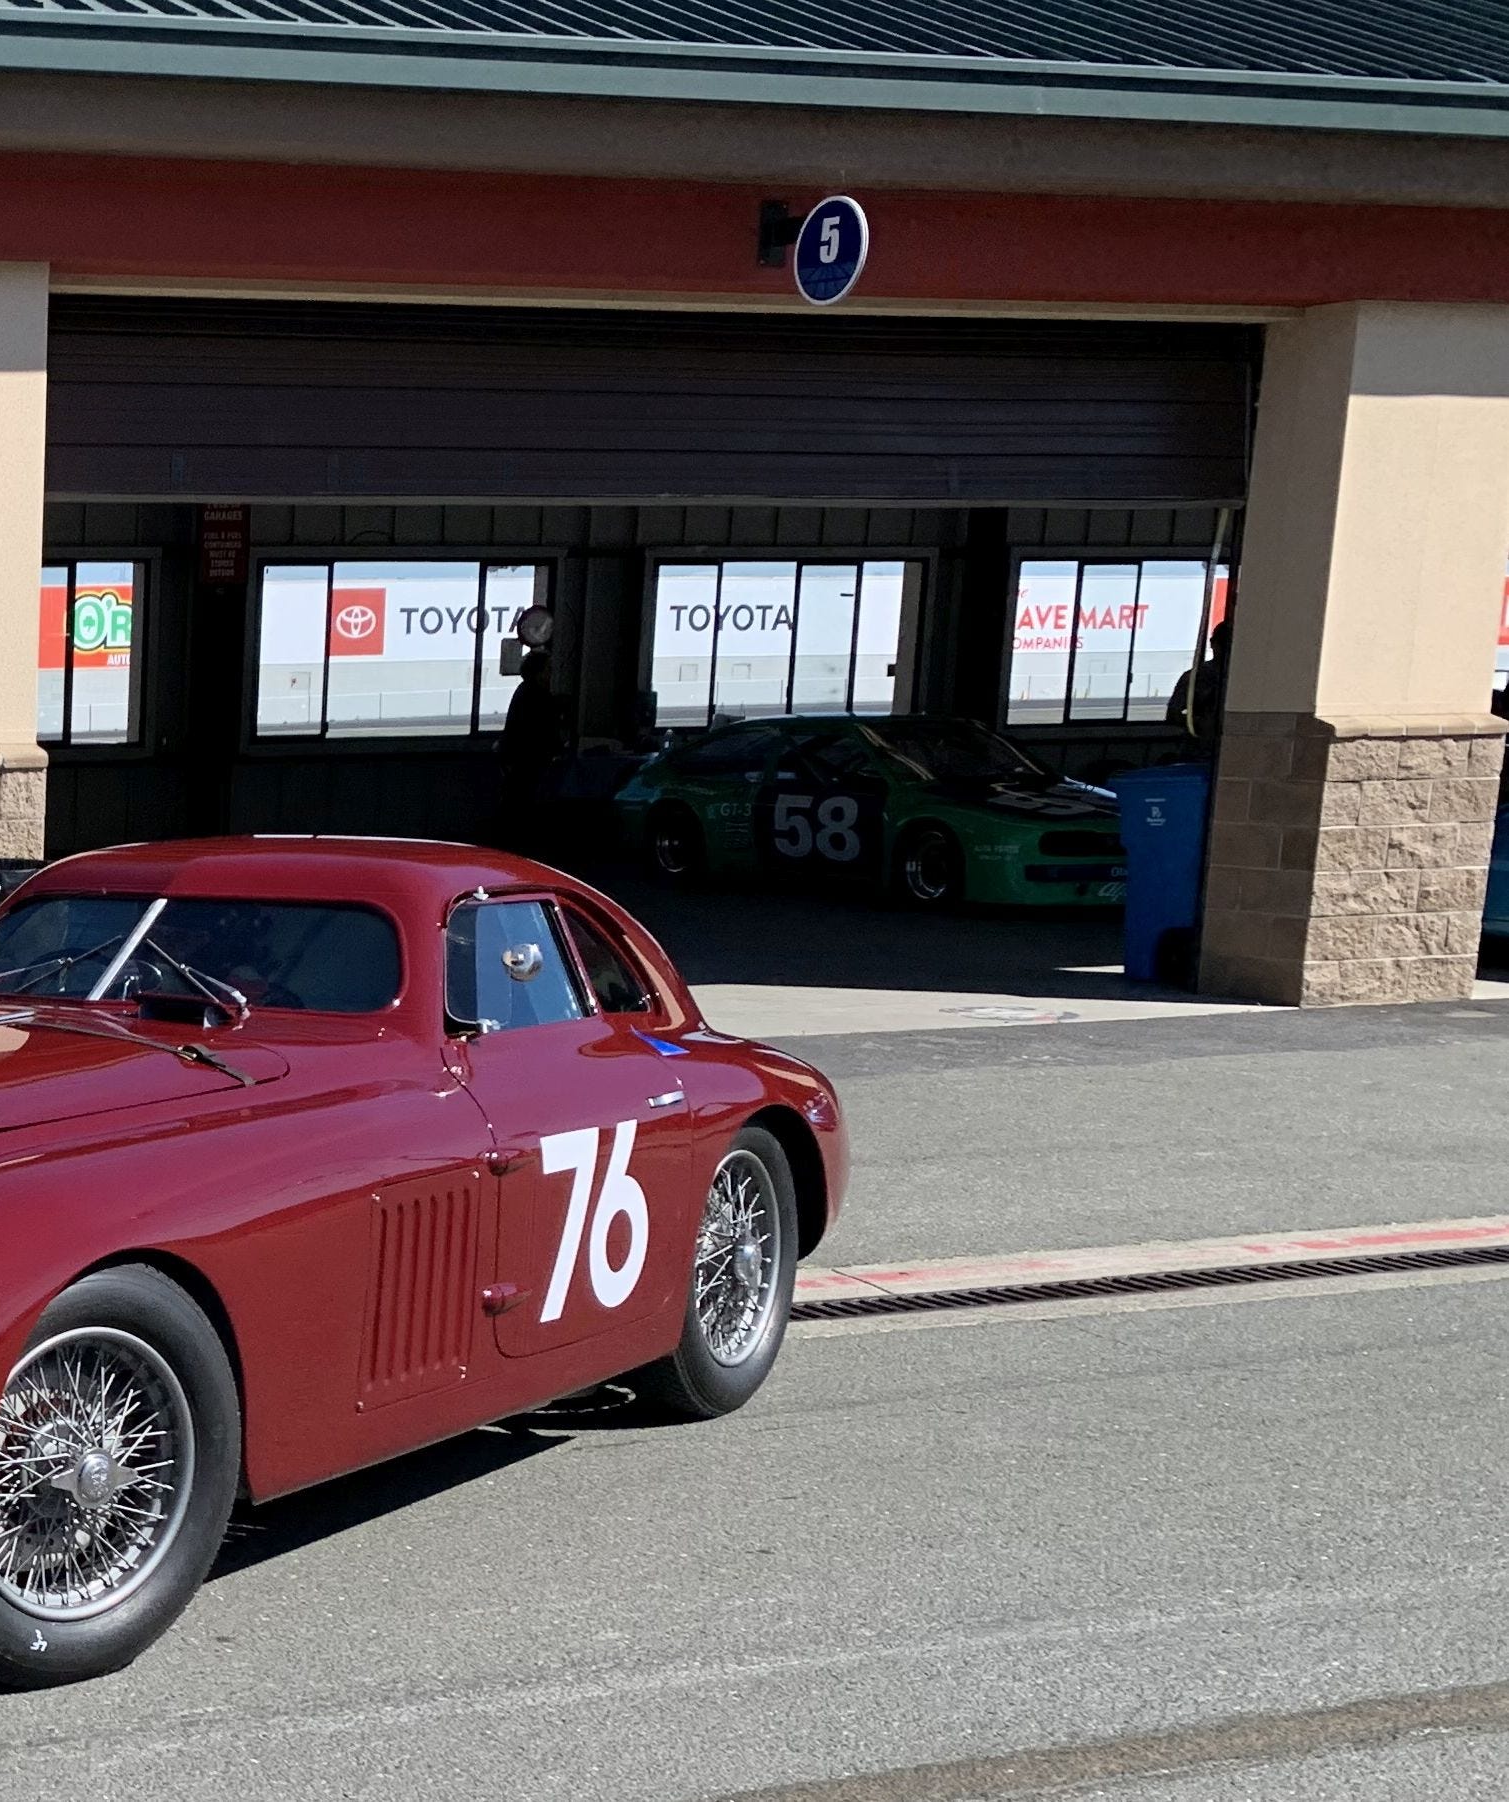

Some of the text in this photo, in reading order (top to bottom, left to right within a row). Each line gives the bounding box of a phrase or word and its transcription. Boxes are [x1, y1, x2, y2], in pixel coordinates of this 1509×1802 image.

[819, 215, 841, 264] 5
[669, 604, 793, 632] TOYOTA
[1078, 604, 1149, 630] MART
[1012, 636, 1084, 650] OMPANIS
[720, 802, 752, 817] GT-3
[774, 794, 860, 862] 58
[539, 1118, 649, 1325] 76
